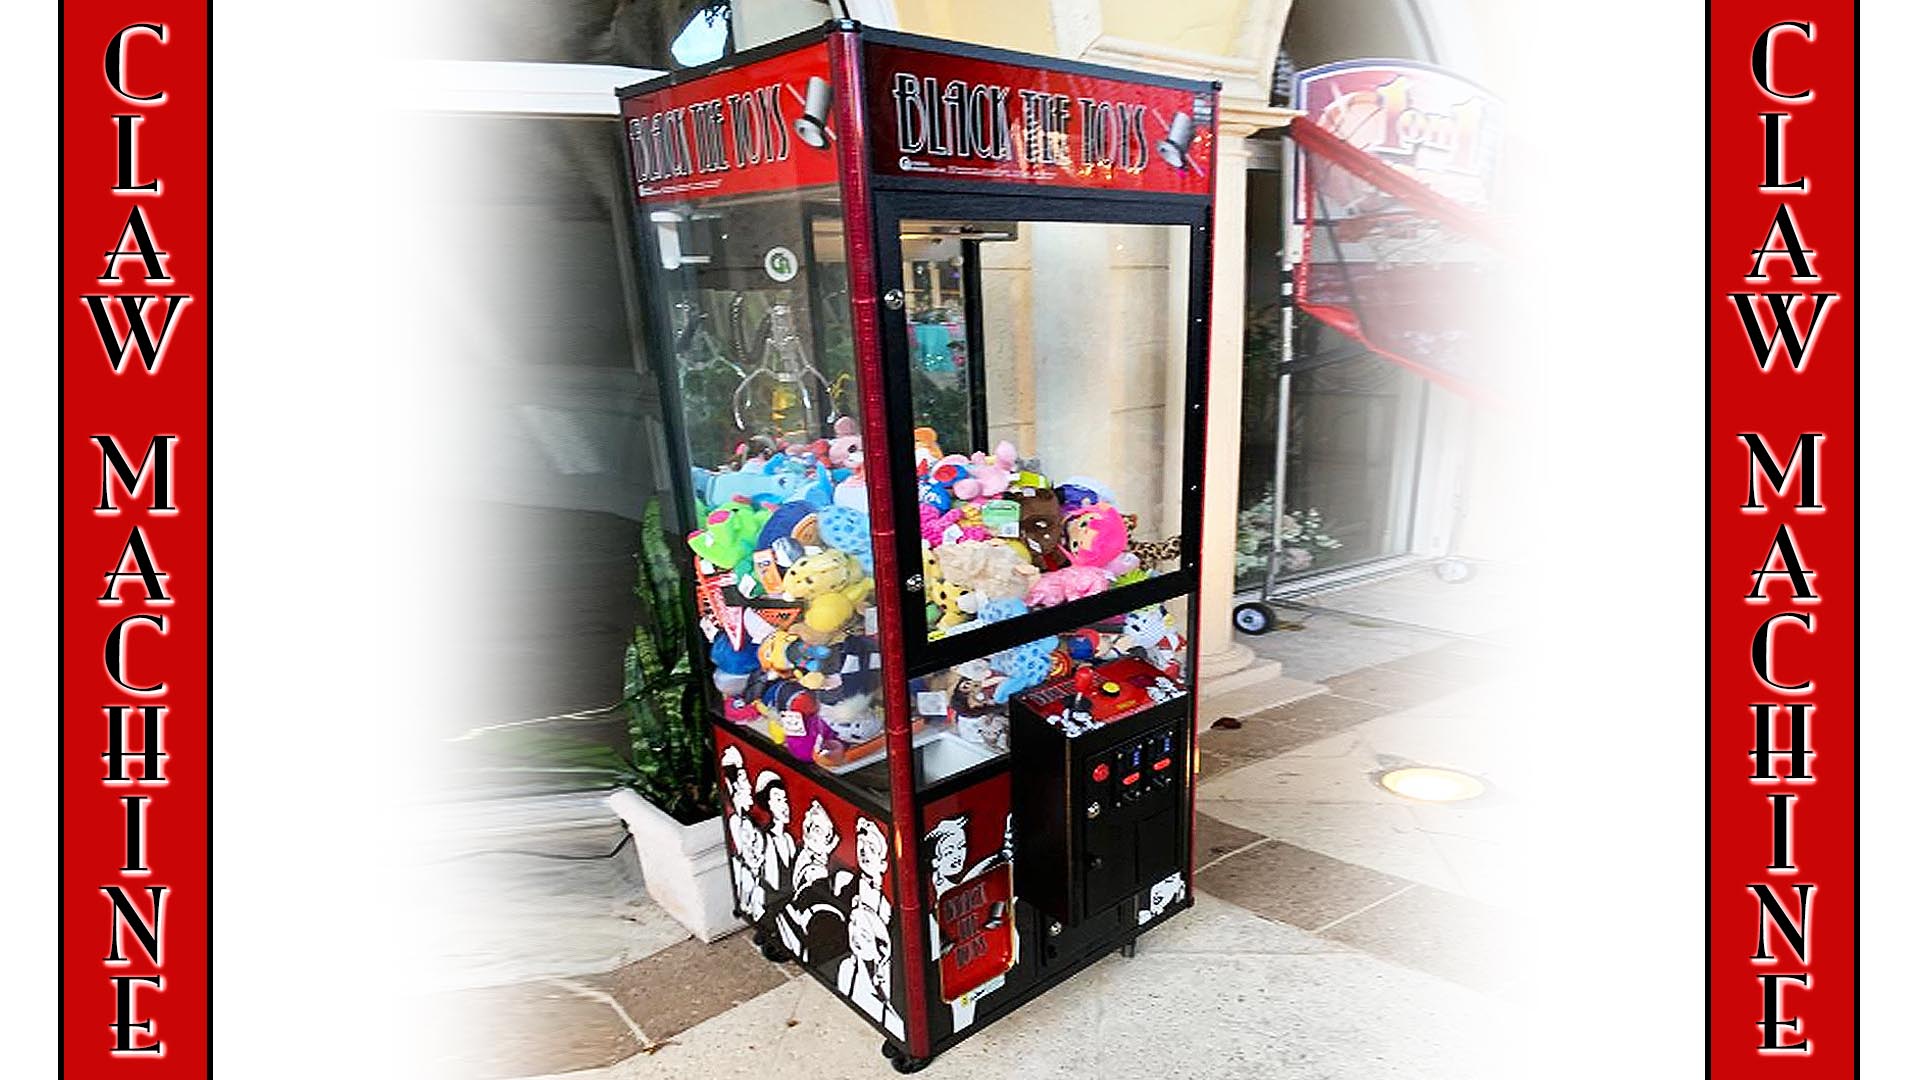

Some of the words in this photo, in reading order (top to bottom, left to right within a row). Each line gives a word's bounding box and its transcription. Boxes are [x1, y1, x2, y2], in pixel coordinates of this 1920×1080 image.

[727, 83, 789, 168] TOYS
[892, 72, 1012, 161] BLACK
[1018, 89, 1071, 165] TIE
[1079, 97, 1149, 171] TOYS
